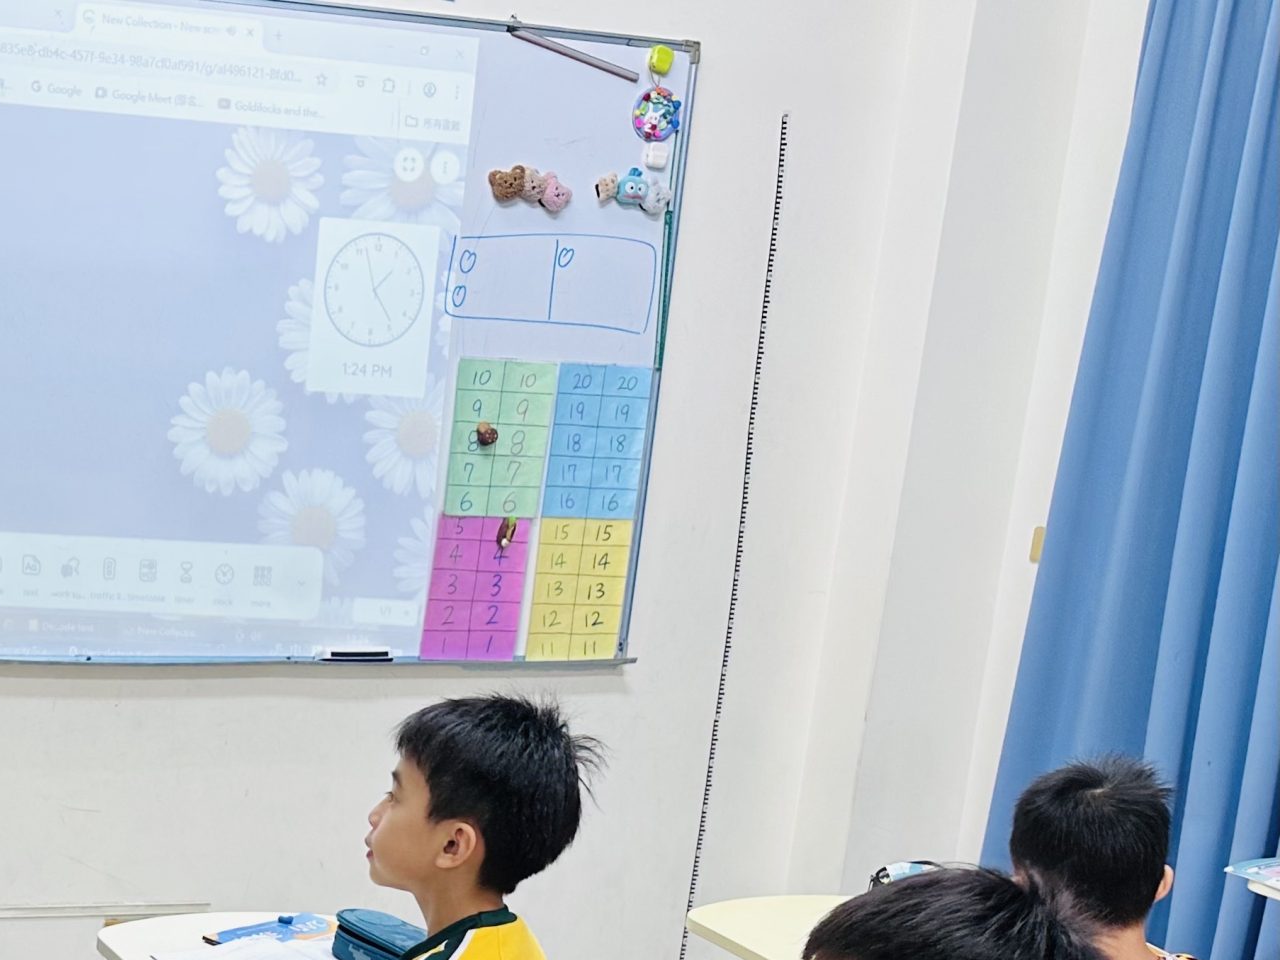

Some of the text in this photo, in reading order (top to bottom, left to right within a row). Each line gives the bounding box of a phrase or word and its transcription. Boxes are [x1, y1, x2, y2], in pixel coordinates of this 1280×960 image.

[102, 14, 123, 26] New
[125, 15, 171, 29] Collection
[47, 83, 82, 98] Google
[111, 89, 146, 104] Google
[235, 101, 281, 115] Goldilocks
[284, 105, 300, 116] and
[342, 362, 392, 378] 1:24 PM
[472, 370, 536, 388] 10 10
[572, 373, 639, 391] 20 20
[472, 399, 529, 422] 9 9
[570, 401, 630, 422] 19 19
[510, 430, 526, 455] 8
[566, 433, 627, 453] 18 18
[464, 461, 521, 485] 7 7
[562, 464, 621, 483] 17 17
[460, 492, 516, 513] 6 6
[559, 494, 620, 511] 16 16
[554, 523, 613, 541] 15 15
[449, 544, 463, 563] 4
[550, 552, 610, 570] 14 14
[447, 573, 502, 596] 3 3
[547, 581, 605, 600] 13 13
[442, 605, 499, 626] 2 2
[542, 610, 604, 628] 12 12
[541, 640, 597, 655] 11 11
